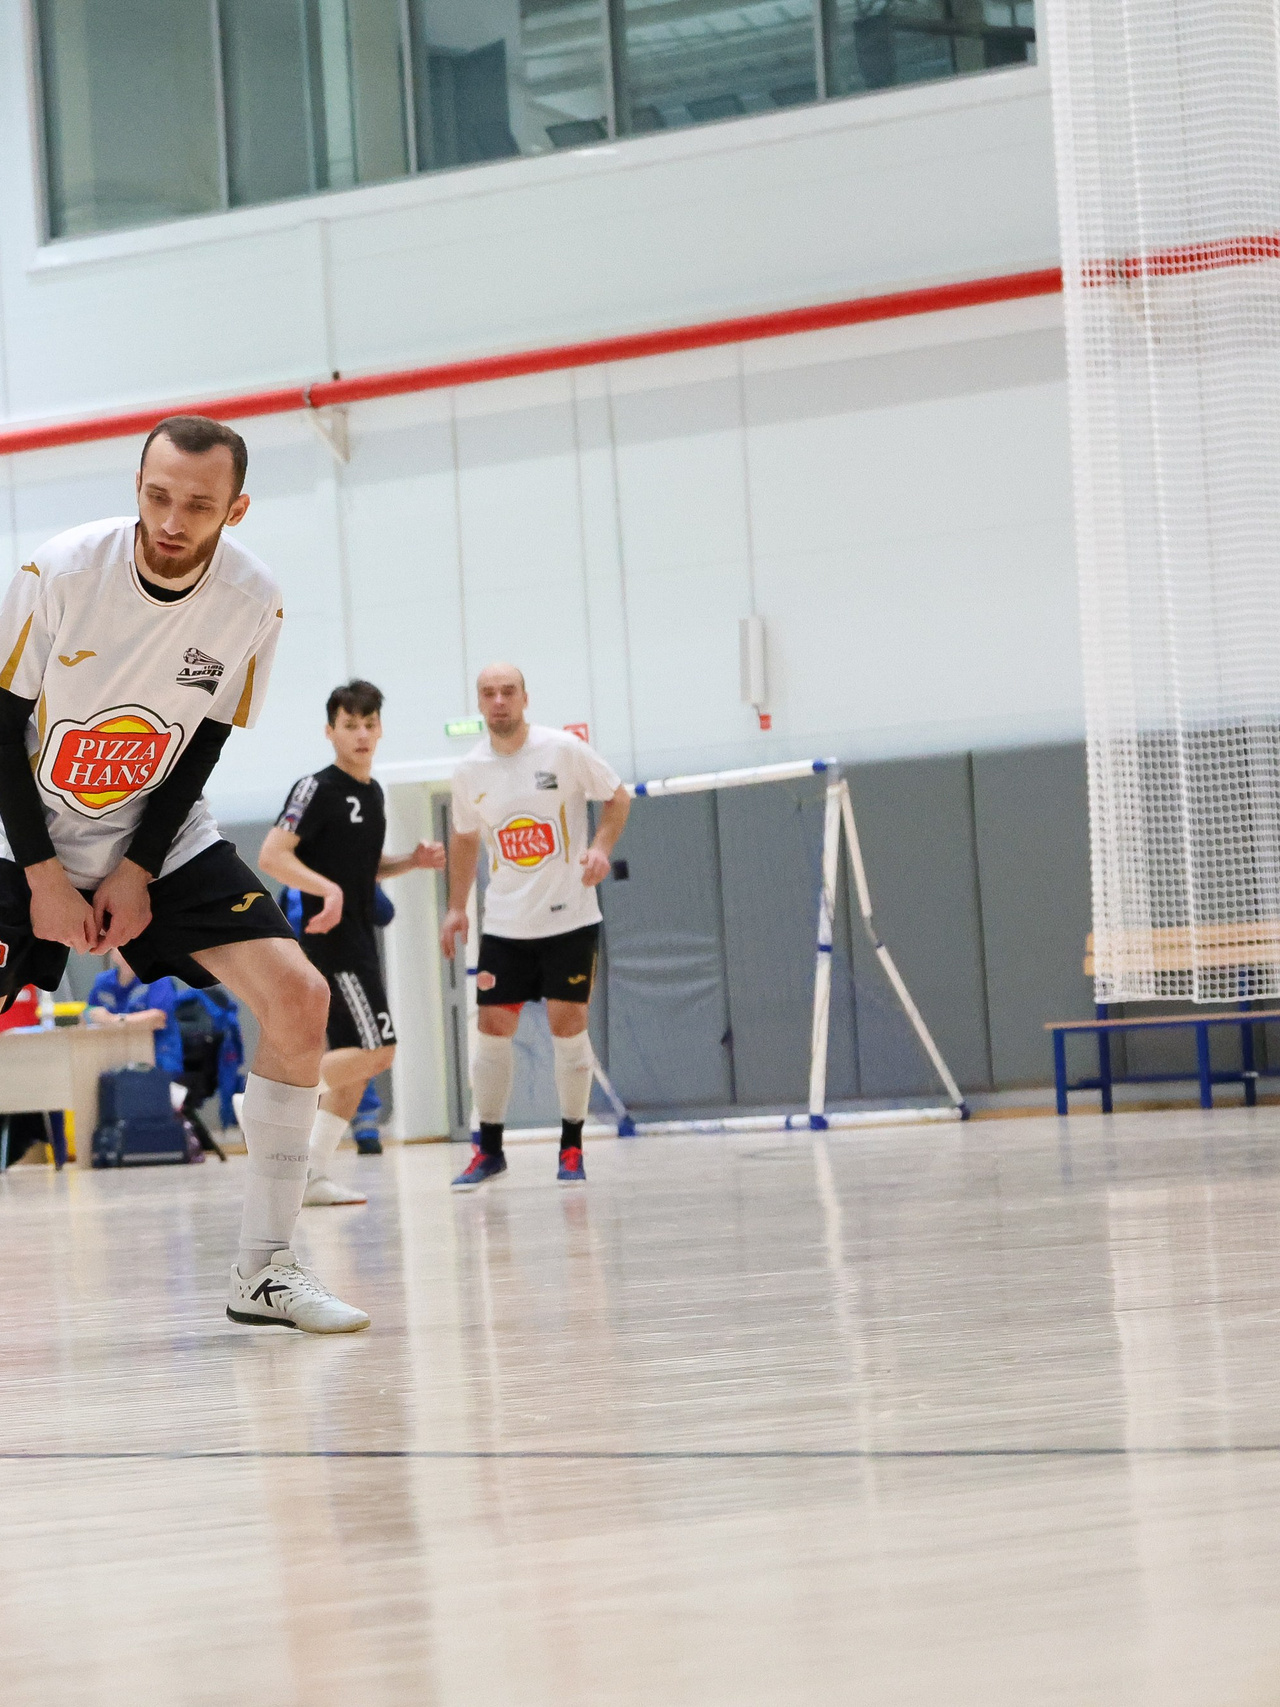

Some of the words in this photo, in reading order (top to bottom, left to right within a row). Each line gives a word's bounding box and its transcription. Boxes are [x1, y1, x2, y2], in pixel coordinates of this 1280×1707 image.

[73, 737, 156, 761] PIZZA
[64, 761, 153, 787] HANS
[346, 796, 363, 823] 2
[503, 828, 546, 844] PIZZA
[506, 842, 550, 858] HANS
[377, 1012, 395, 1040] 2
